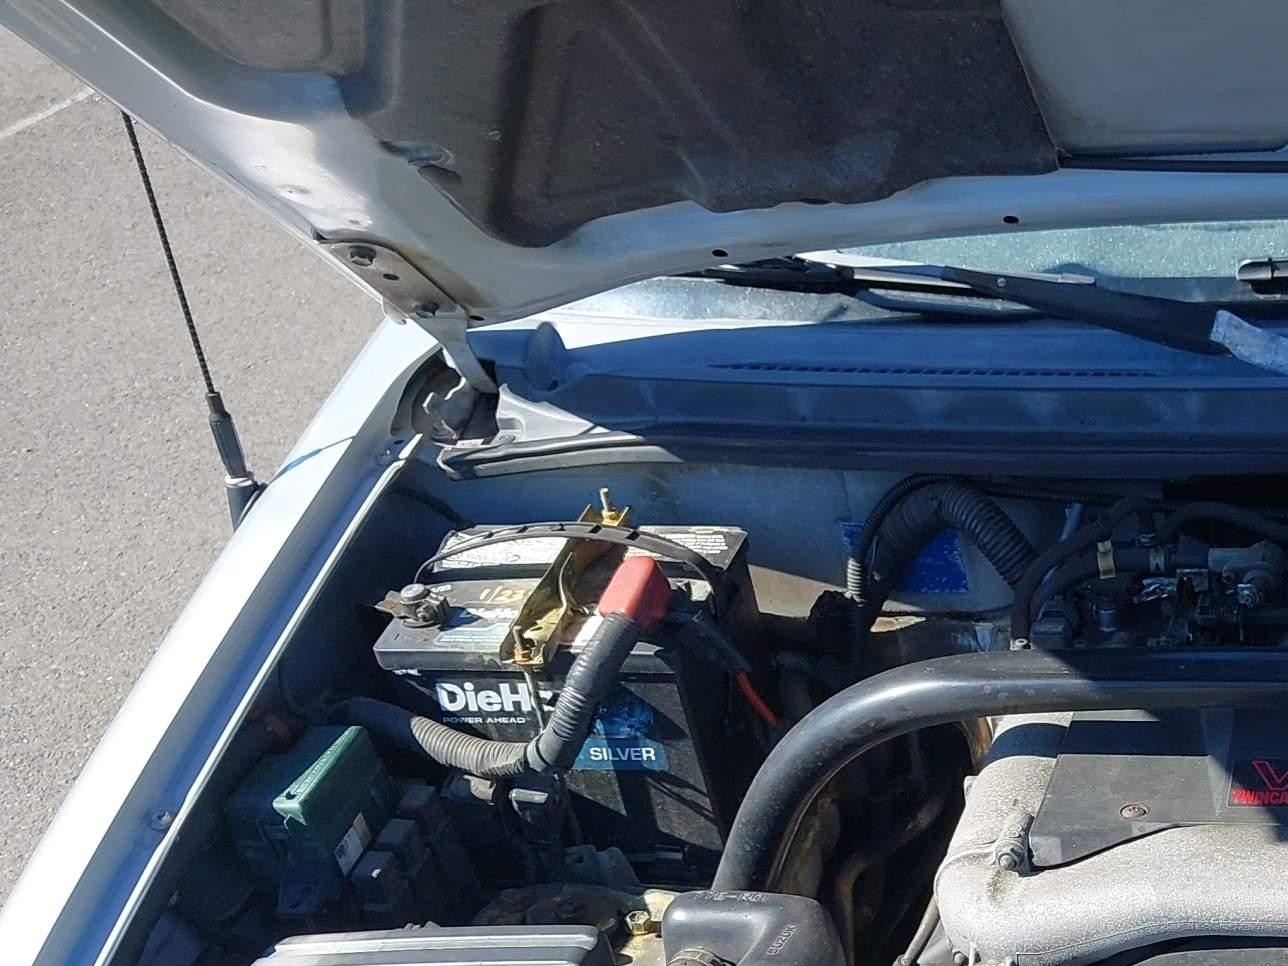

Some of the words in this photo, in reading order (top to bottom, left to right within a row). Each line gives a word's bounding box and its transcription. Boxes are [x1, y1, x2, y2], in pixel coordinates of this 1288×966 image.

[479, 586, 526, 604] 1/23
[443, 716, 483, 724] POWER
[589, 747, 656, 761] SILVER
